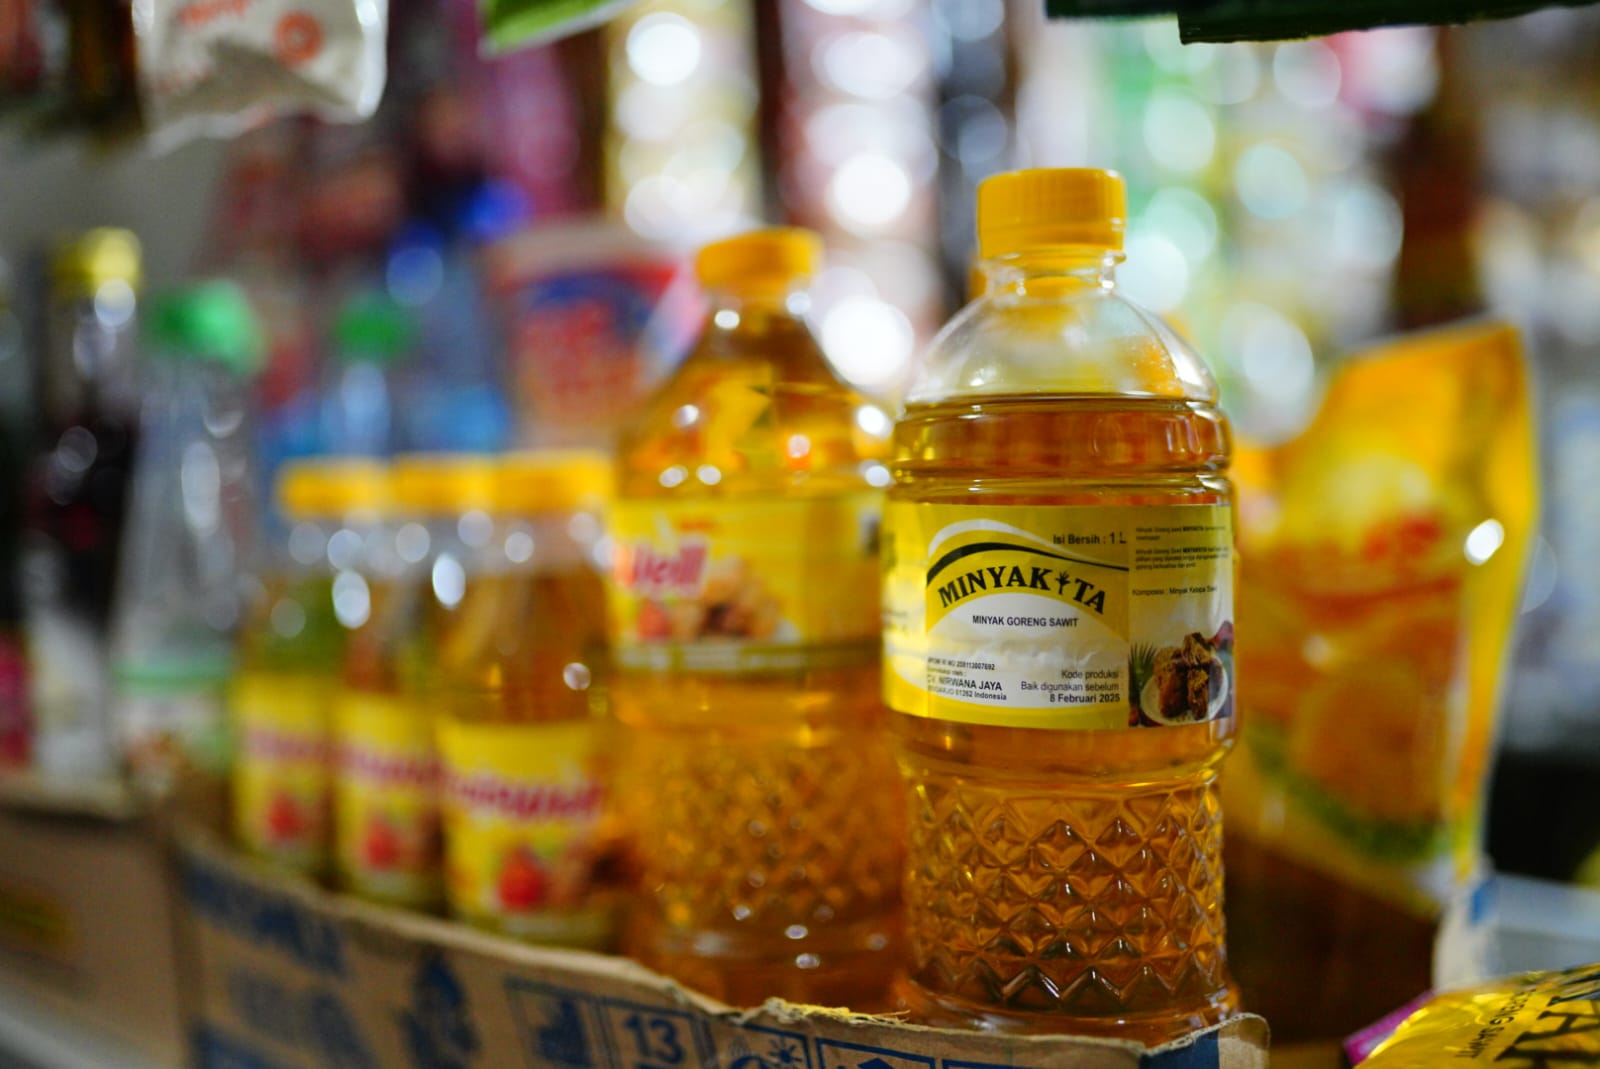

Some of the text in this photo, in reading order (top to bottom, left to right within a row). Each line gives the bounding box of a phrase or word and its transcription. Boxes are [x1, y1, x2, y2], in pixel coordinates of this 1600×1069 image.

[1053, 533, 1065, 544] Isi
[1067, 533, 1100, 544] Bersih
[1109, 531, 1115, 544] 1
[1119, 531, 1127, 544] L
[972, 614, 1079, 628] MINYAK GORENG SAWIT
[1061, 670, 1119, 680] Kode produksi
[979, 680, 1003, 692] JAYA
[1021, 681, 1119, 693] Baik digunakan sebelum
[974, 690, 1007, 701] Indonesia
[1058, 692, 1097, 703] Februari
[1098, 692, 1121, 703] 2025
[623, 1014, 686, 1065] 13
